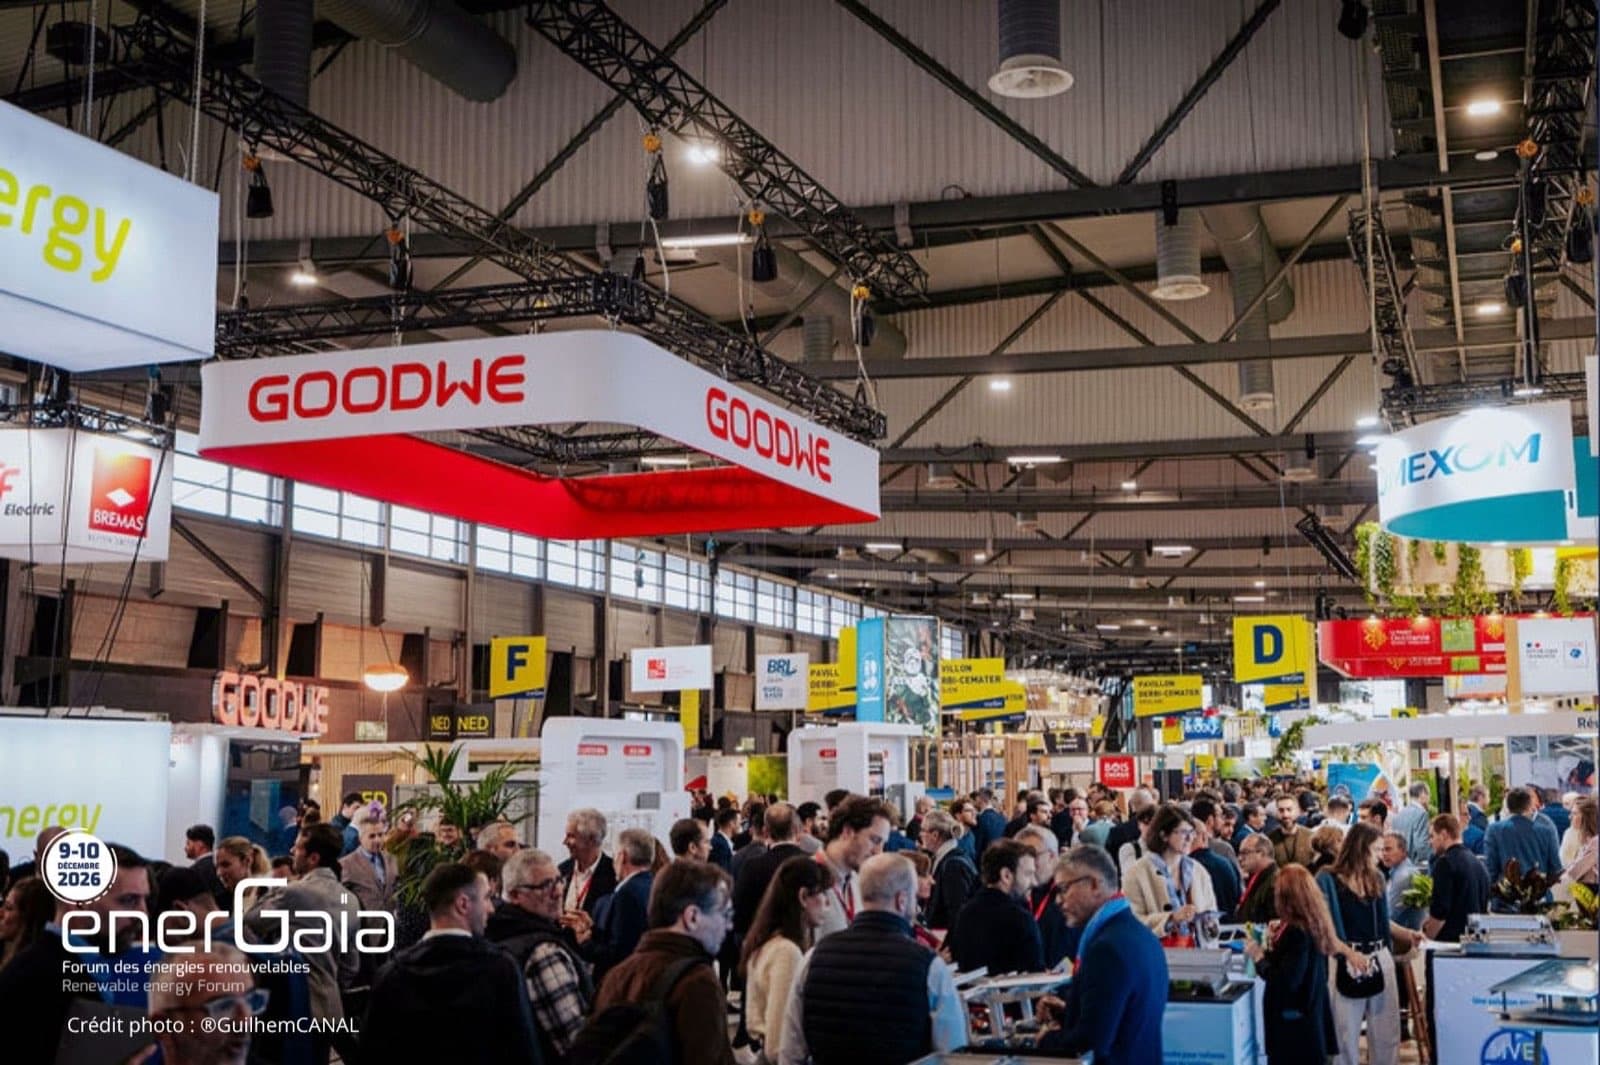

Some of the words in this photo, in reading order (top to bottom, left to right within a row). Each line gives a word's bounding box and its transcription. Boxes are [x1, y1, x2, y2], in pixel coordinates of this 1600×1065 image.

[248, 353, 527, 423] GOODWE
[706, 386, 832, 484] GOODWE
[4, 503, 55, 516] Electric
[93, 508, 144, 531] BREMAS
[1253, 624, 1284, 664] D
[506, 645, 530, 681] F
[767, 659, 798, 676] BRL
[1138, 680, 1175, 688] PAVILLON
[1138, 689, 1200, 698] DERBI-CEMATER
[212, 670, 330, 735] GOODWE
[431, 716, 451, 731] NED
[457, 715, 489, 731] NED
